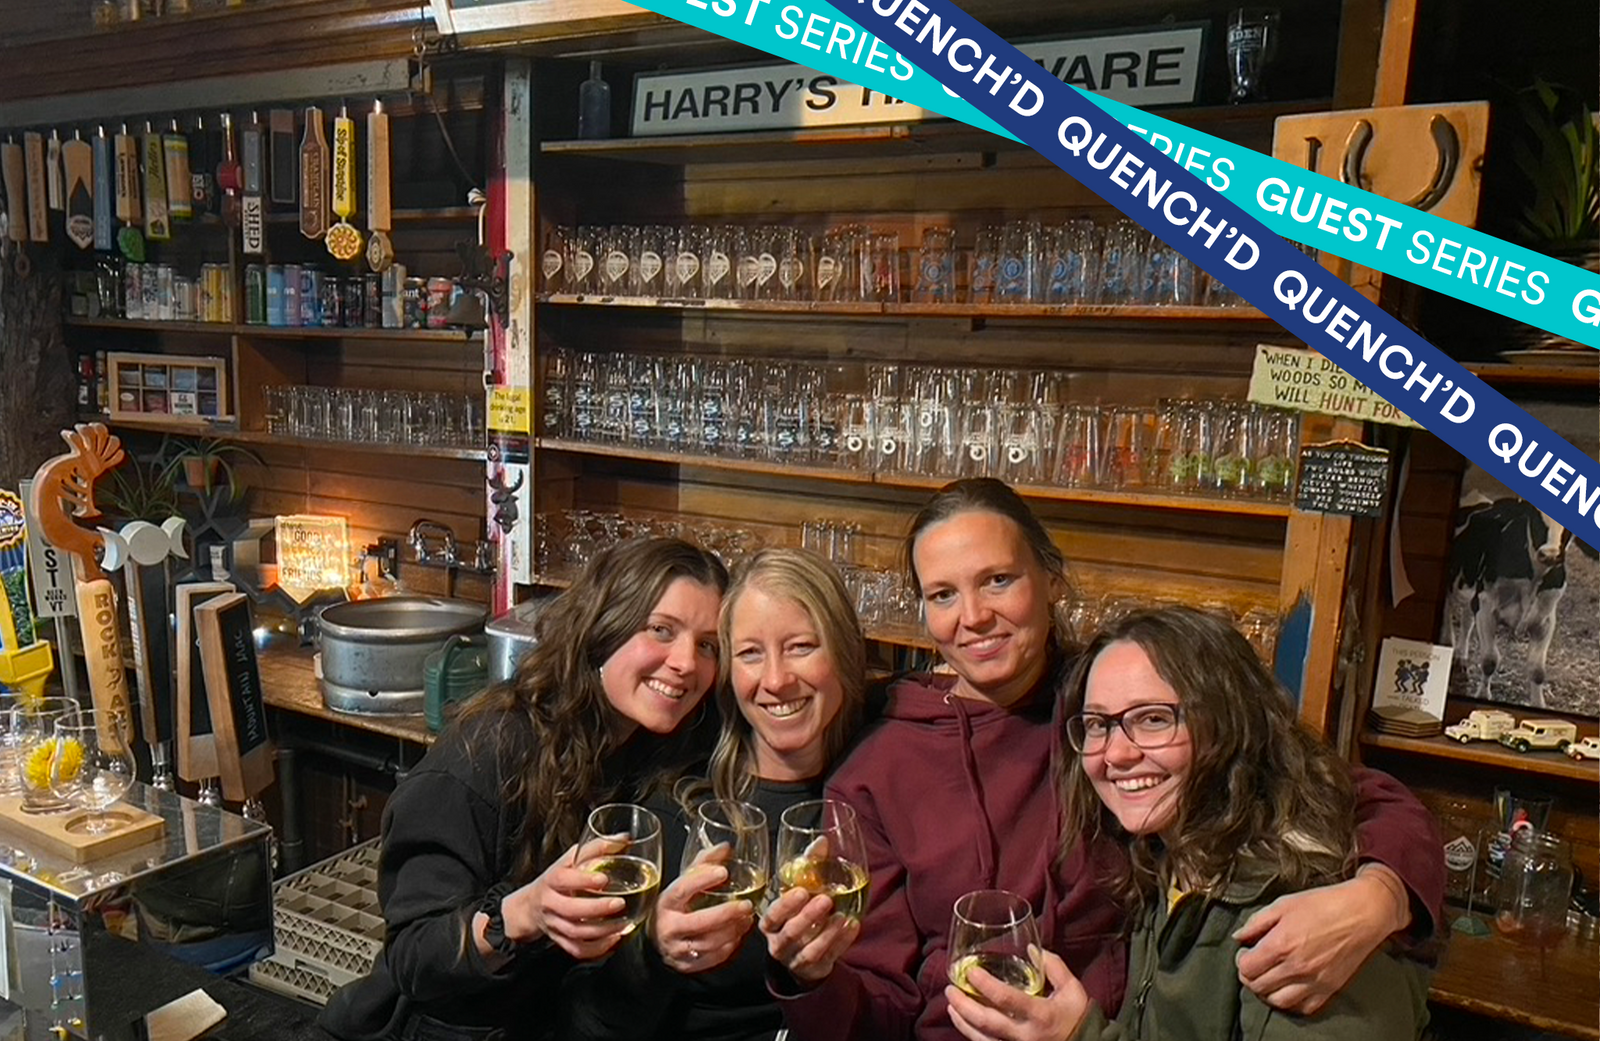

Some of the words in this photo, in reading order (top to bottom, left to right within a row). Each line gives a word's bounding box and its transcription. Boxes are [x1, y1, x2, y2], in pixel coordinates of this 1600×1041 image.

[643, 75, 837, 122] HARRY'S
[247, 202, 260, 249] SHED
[1265, 351, 1301, 367] WHEN
[1307, 357, 1314, 370] I
[1270, 368, 1321, 386] WOODS
[1328, 375, 1347, 390] SO
[1353, 379, 1374, 395] M
[1275, 385, 1309, 404] WILL
[1319, 391, 1368, 413] HUNT
[49, 601, 64, 612] VT
[94, 593, 117, 659] ROCK
[237, 671, 259, 741] MOUNTAIN
